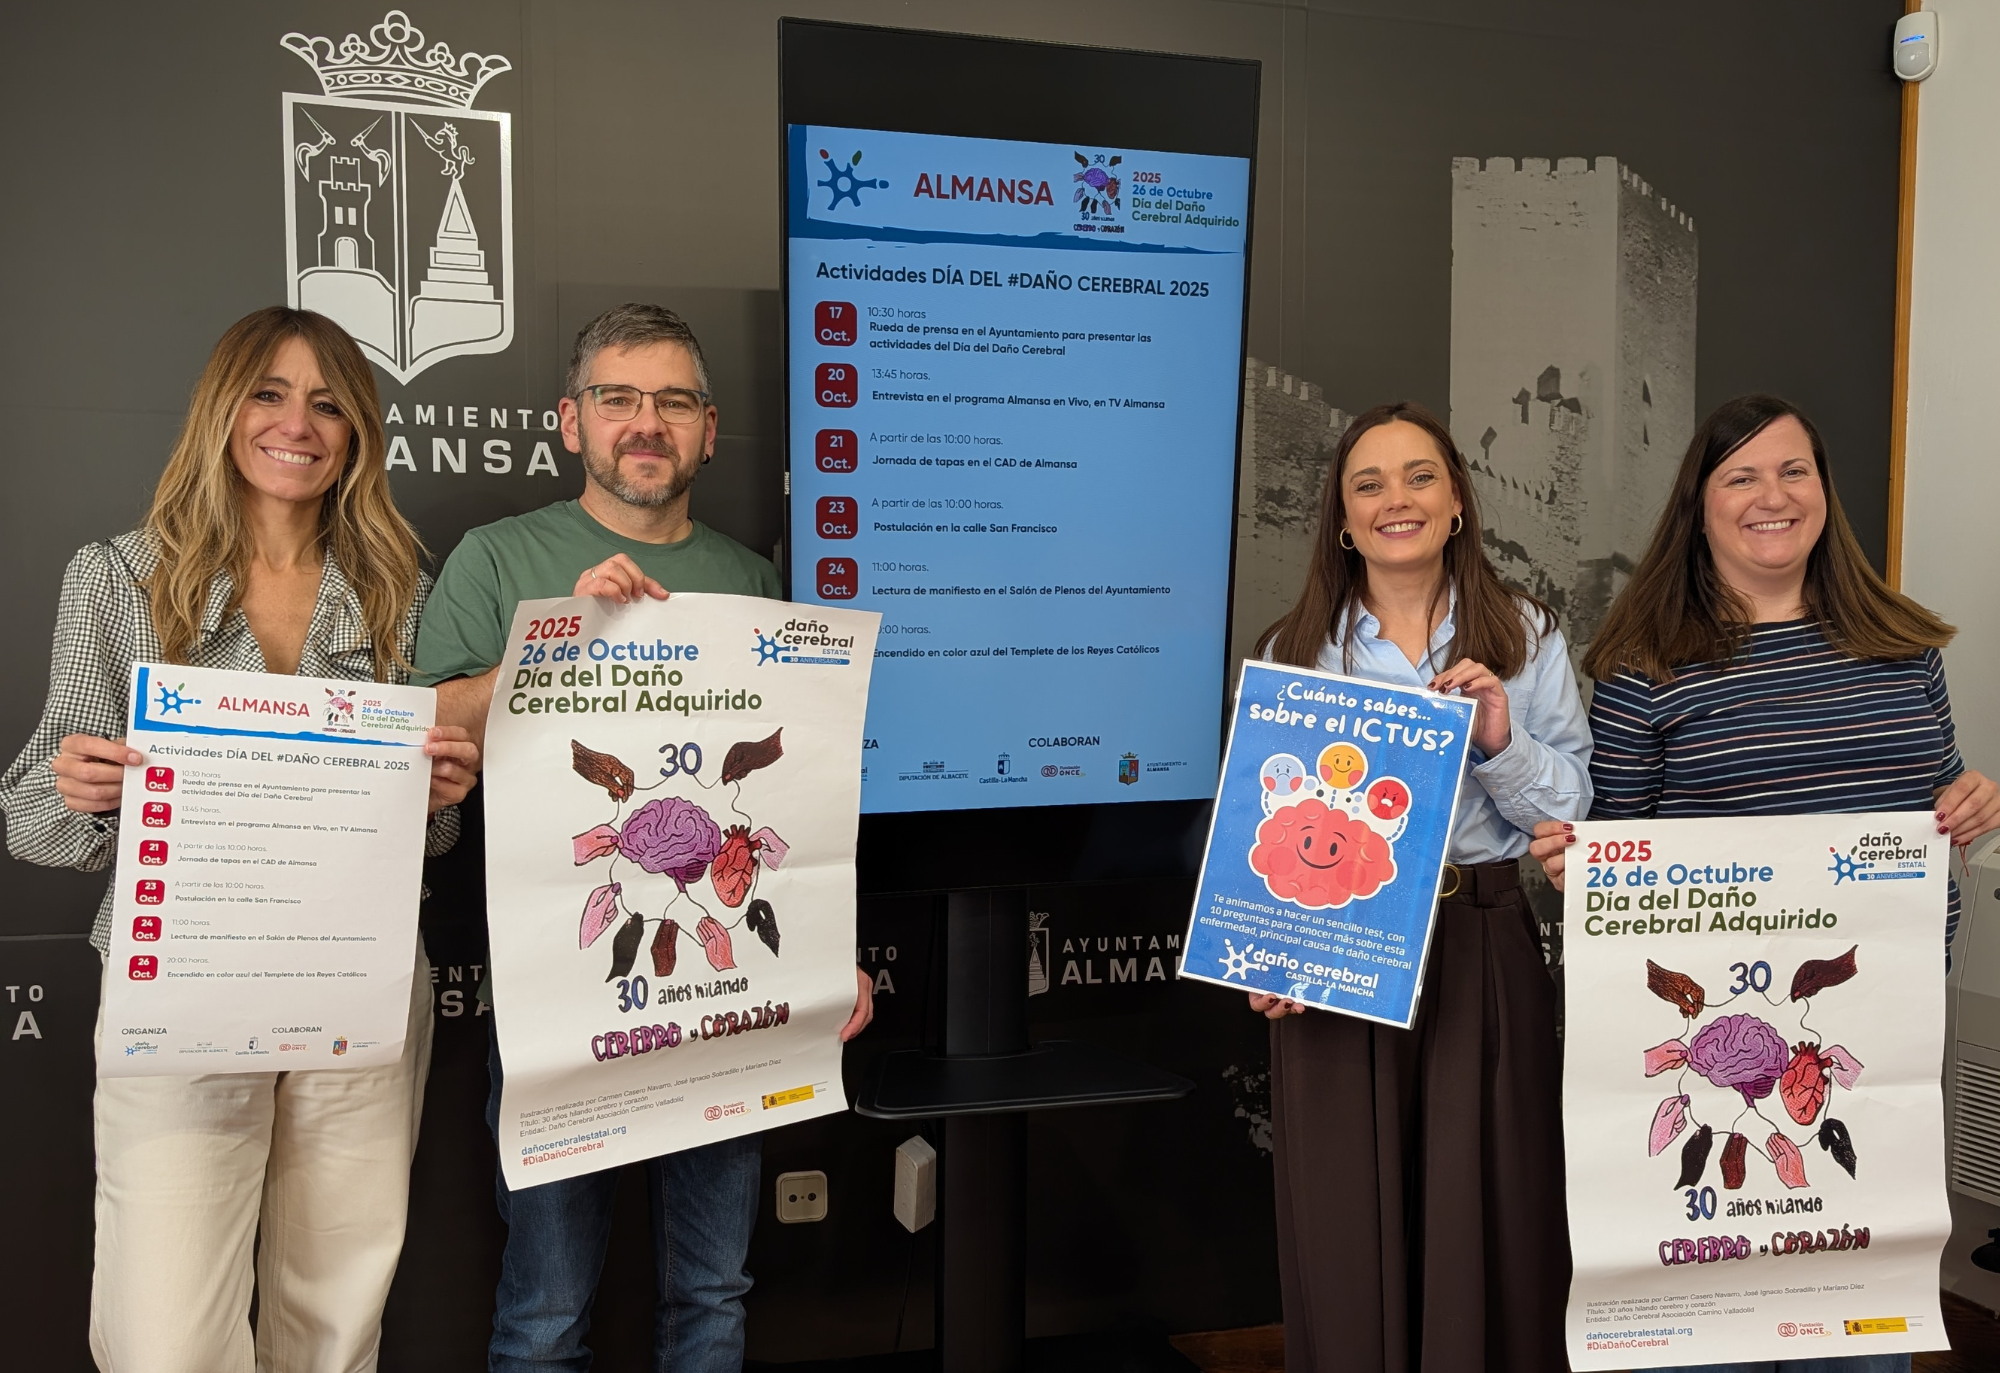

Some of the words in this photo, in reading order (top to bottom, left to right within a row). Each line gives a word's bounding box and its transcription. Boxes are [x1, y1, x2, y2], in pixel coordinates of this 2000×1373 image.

[1132, 171, 1161, 183] 2025
[913, 172, 1054, 206] ALMANSA
[1132, 184, 1146, 195] 26
[1149, 185, 1163, 196] de
[1166, 186, 1213, 200] Octubre
[1154, 199, 1172, 210] del
[1175, 200, 1205, 212] Daño
[1131, 210, 1182, 223] Cerebral
[1184, 213, 1239, 228] Adquirido
[816, 262, 926, 283] Actividades
[932, 268, 964, 285] DÍA
[970, 270, 1002, 287] DEL
[1007, 272, 1072, 290] #DAÑO
[1077, 275, 1165, 295] CEREBRAL
[1169, 280, 1209, 297] 2025
[829, 306, 842, 319] 17
[867, 306, 894, 317] 10:30
[897, 308, 926, 319] horas
[820, 328, 850, 342] Oct.
[869, 321, 903, 332] Rueda
[906, 323, 920, 333] de
[923, 326, 958, 336] prensa
[976, 326, 986, 336] el
[988, 326, 1059, 339] Ayuntamiento
[1061, 332, 1085, 341] para
[1087, 333, 1135, 342] presentar
[1137, 332, 1151, 342] las
[869, 338, 931, 350] actividades
[934, 341, 950, 351] del
[973, 342, 989, 352] del
[992, 343, 1019, 354] Daño
[1021, 344, 1065, 355] Cerebral
[828, 368, 845, 380] 20
[821, 390, 851, 403] Oct.
[872, 390, 924, 401] Entrevista
[942, 393, 951, 402] el
[954, 395, 1004, 406] programa
[1007, 395, 1050, 405] Almansa
[1068, 396, 1091, 408] Vivo,
[1108, 398, 1121, 407] TV
[1122, 398, 1165, 408] Almansa
[386, 403, 558, 430] AMIENTO
[830, 435, 843, 447] 21
[385, 436, 559, 476] ANSA
[822, 456, 851, 469] Oct.
[828, 501, 845, 513] 23
[822, 522, 851, 534] Oct.
[828, 562, 845, 574] 24
[822, 583, 851, 595] Oct.
[524, 615, 582, 640] 2025
[784, 618, 828, 633] daño
[783, 633, 854, 648] cerebral
[518, 642, 546, 666] 26
[552, 641, 580, 662] de
[588, 639, 699, 661] Octubre
[560, 664, 601, 687] del
[611, 663, 683, 687] Daño
[217, 696, 310, 717] ALMANSA
[508, 689, 626, 714] Cerebral
[634, 688, 762, 716] Adquirido
[1276, 682, 1357, 708] ¿Cuánto
[1363, 697, 1431, 720] sabes...
[1249, 702, 1316, 728] sobre
[1325, 714, 1345, 734] el
[1352, 718, 1454, 756] ICTUS?
[1028, 736, 1100, 748] COLABORAN
[148, 744, 223, 758] Actividades
[226, 749, 247, 760] DÍA
[251, 751, 273, 762] DEL
[276, 752, 320, 764] #DAÑO
[323, 756, 381, 769] CEREBRAL
[383, 760, 410, 771] 2025
[658, 742, 702, 777] 30
[1587, 840, 1652, 863] 2025
[1859, 833, 1902, 847] daño
[1858, 846, 1927, 860] cerebral
[1586, 866, 1617, 888] 26
[1625, 865, 1658, 887] de
[1666, 862, 1773, 885] Octubre
[1638, 887, 1679, 910] del
[1687, 887, 1756, 909] Daño
[1214, 893, 1224, 903] Te
[1226, 897, 1275, 914] animamos
[1283, 908, 1311, 922] hacer
[1312, 916, 1324, 925] un
[1326, 919, 1362, 933] sencillo
[1364, 927, 1384, 940] test,
[1387, 933, 1405, 943] con
[1584, 911, 1701, 936] Cerebral
[1708, 908, 1837, 935] Adquirido
[1210, 905, 1222, 915] 10
[1222, 910, 1270, 926] preguntas
[1270, 919, 1292, 930] para
[1294, 924, 1333, 939] conocer
[1333, 933, 1354, 944] más
[1355, 938, 1382, 951] sobre
[1384, 945, 1405, 956] esta
[1063, 934, 1180, 952] AYUNTAM
[1200, 916, 1257, 936] enfermedad,
[1260, 929, 1302, 944] principal
[1302, 939, 1330, 952] causa
[1332, 944, 1344, 955] de
[1345, 948, 1370, 961] daño
[1371, 954, 1412, 970] cerebral
[1061, 956, 1182, 984] ALMA
[1254, 948, 1298, 970] daño
[1303, 962, 1379, 988] cerebral
[1728, 960, 1772, 995] 30
[616, 974, 648, 1012] 30
[657, 984, 692, 1006] años
[1285, 972, 1336, 988] CASTILLA-LA
[1336, 983, 1375, 998] MANCHA
[591, 1022, 682, 1062] CEREBRO
[700, 1000, 790, 1042] CORAZÓN
[521, 1124, 626, 1156] dañocerebralestatal.org
[1684, 1186, 1717, 1222] 30
[1726, 1198, 1762, 1218] años
[1659, 1234, 1751, 1266] CEREBRO
[1770, 1223, 1870, 1257] CORAZÓN
[1586, 1326, 1692, 1341] dañocerebralestatal.org
[1799, 1328, 1824, 1336] ONCE
